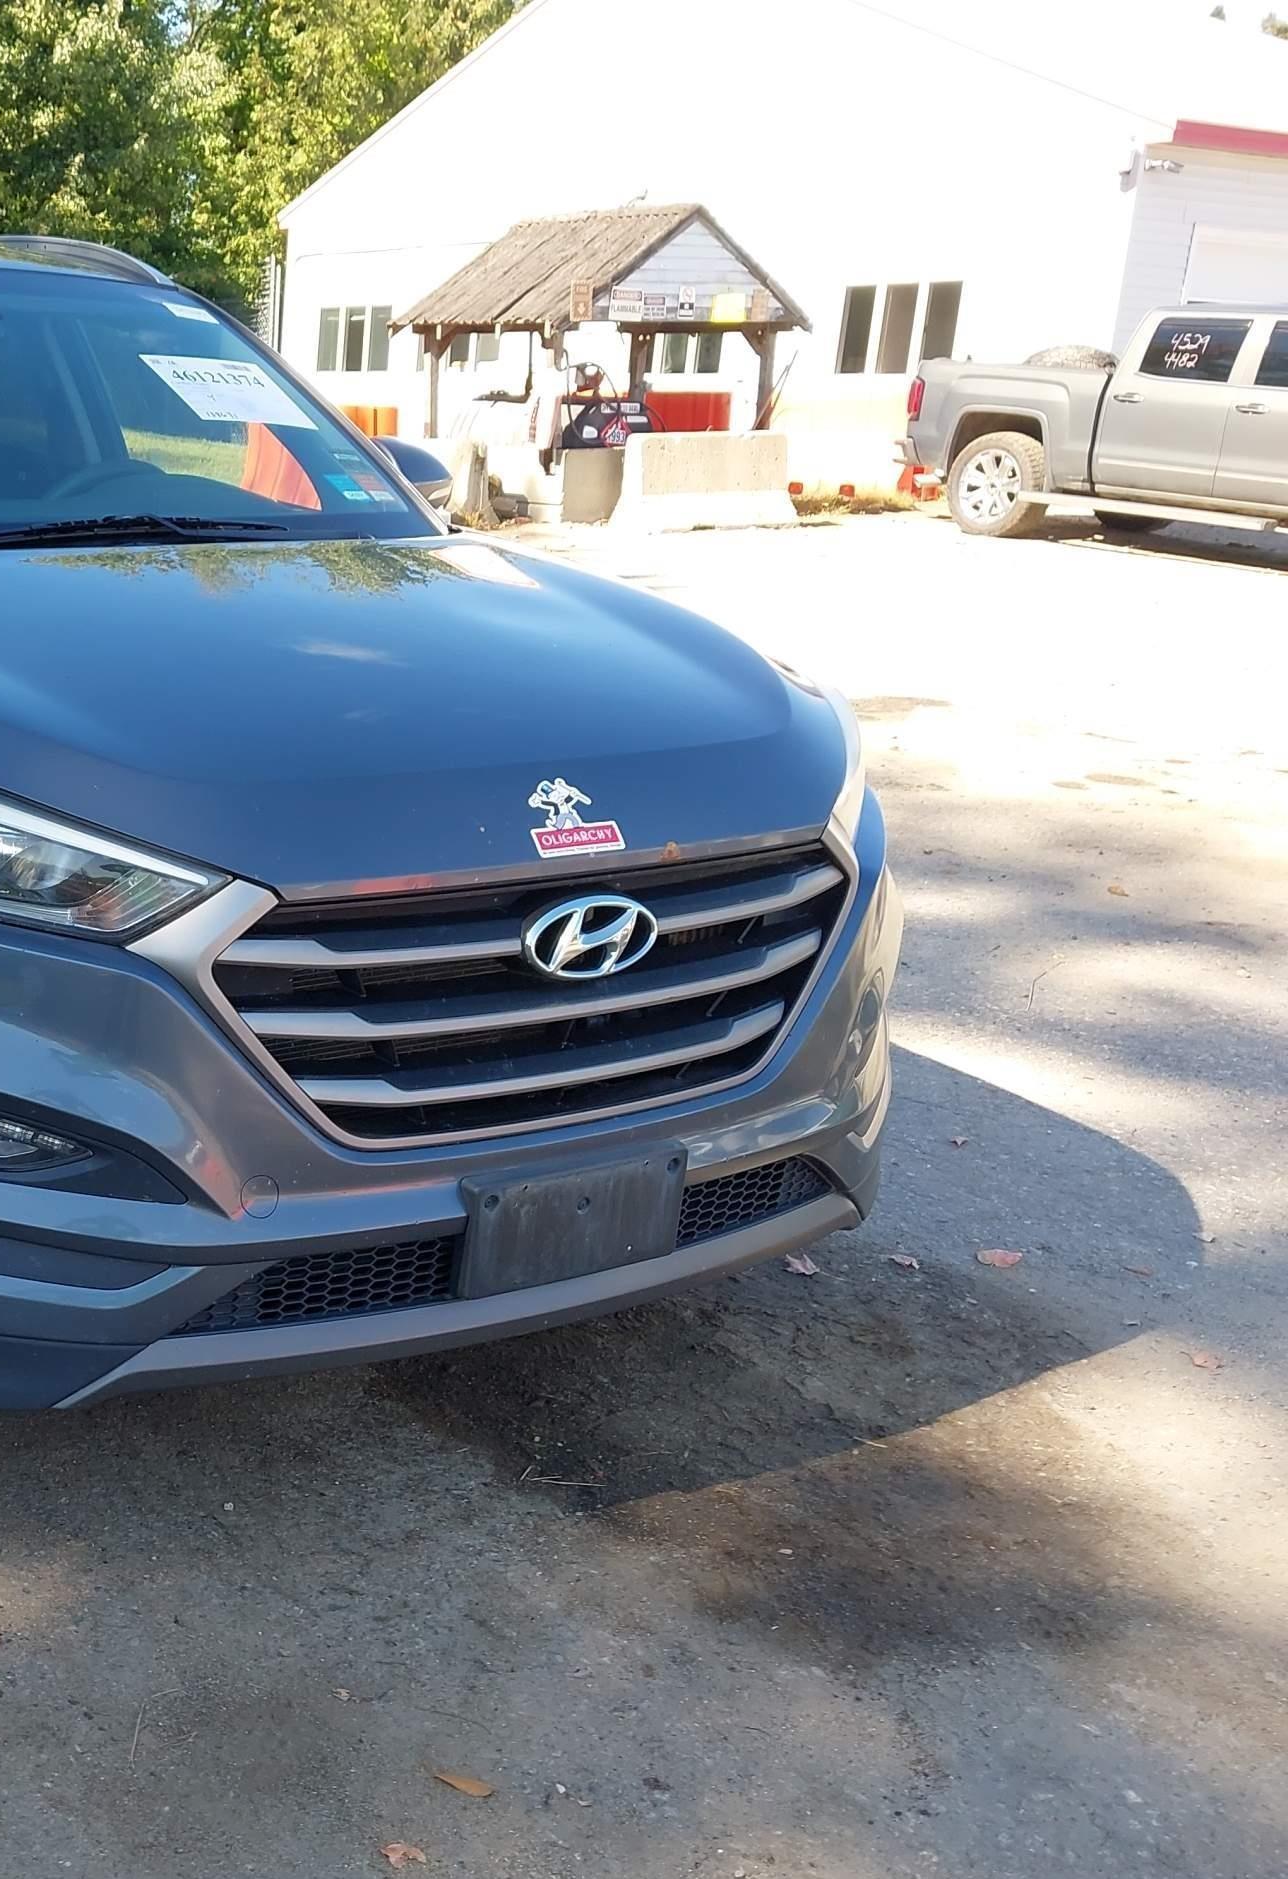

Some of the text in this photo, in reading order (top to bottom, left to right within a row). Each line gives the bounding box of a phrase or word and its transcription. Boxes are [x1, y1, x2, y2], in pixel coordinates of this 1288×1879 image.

[1170, 332, 1212, 355] 4529
[1164, 351, 1199, 370] 4482
[172, 369, 265, 388] 46121374
[541, 828, 613, 846] OLIGARCHY
